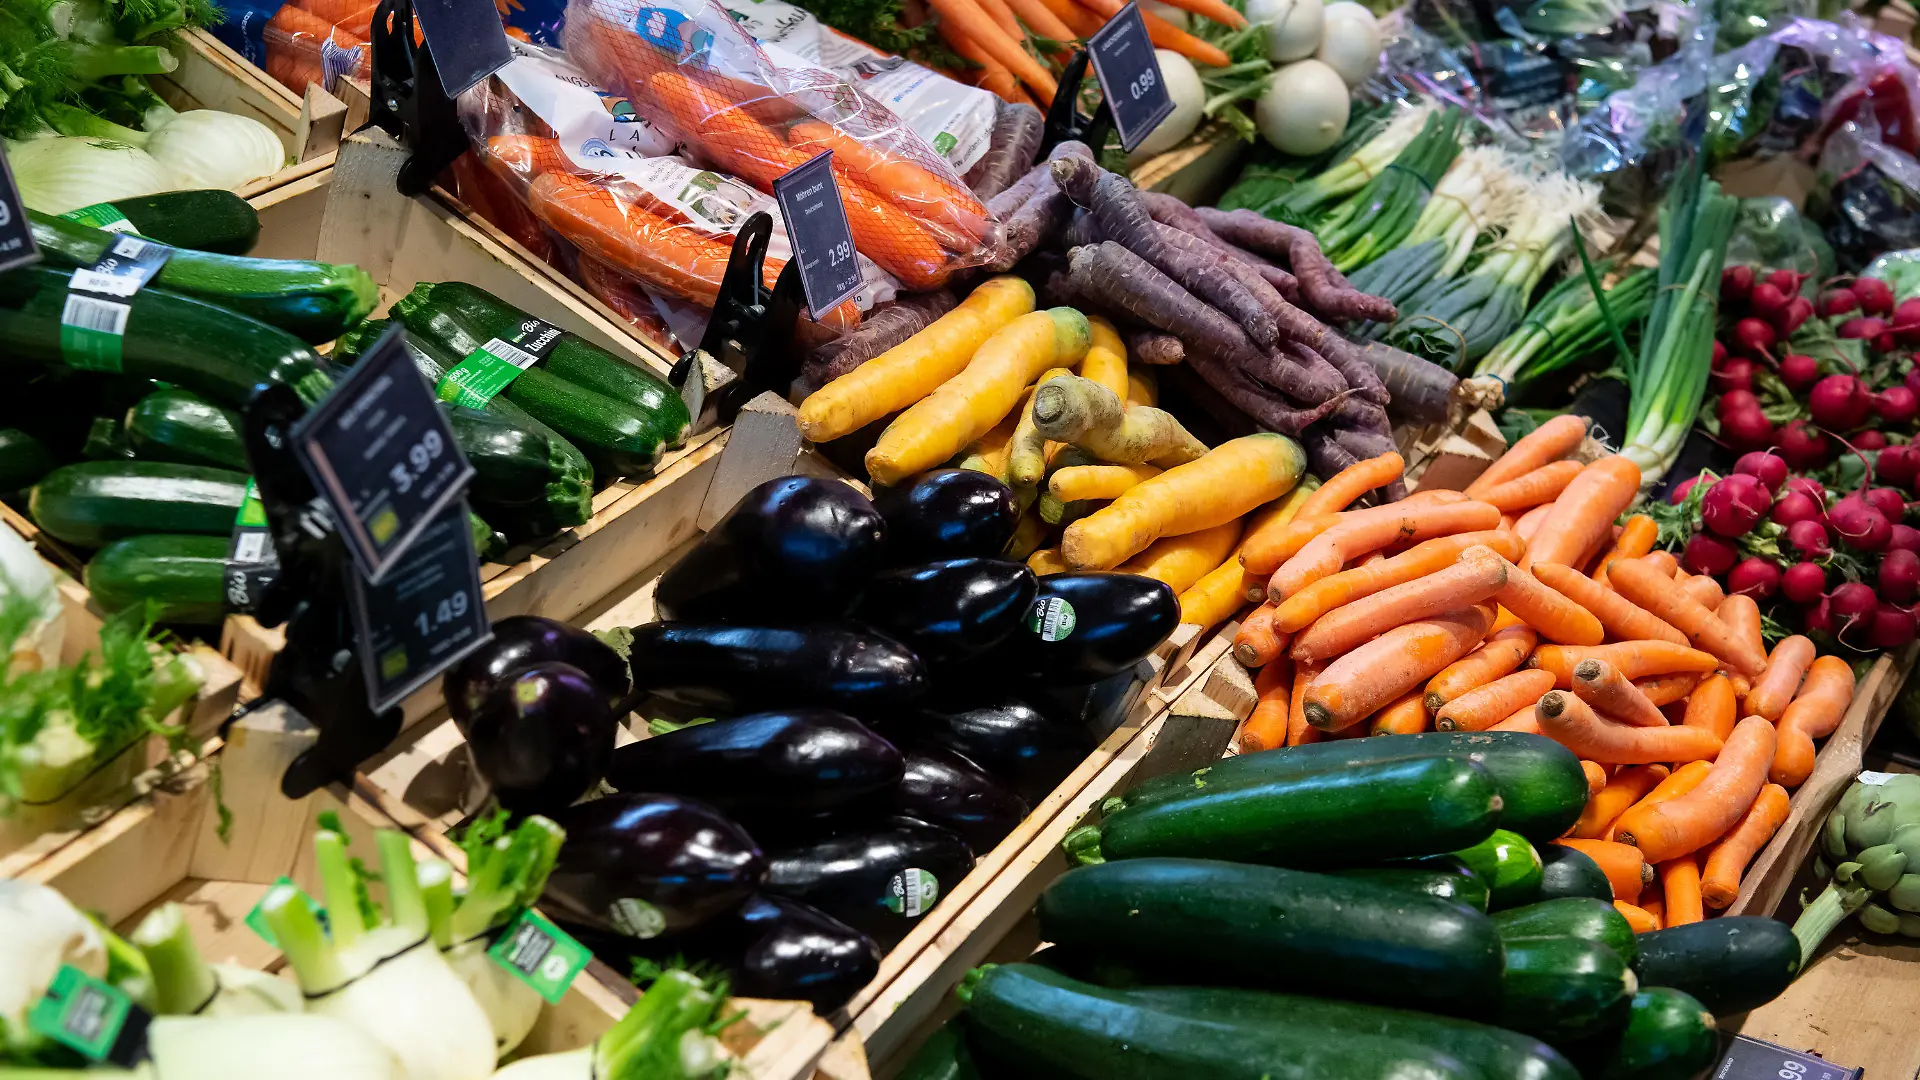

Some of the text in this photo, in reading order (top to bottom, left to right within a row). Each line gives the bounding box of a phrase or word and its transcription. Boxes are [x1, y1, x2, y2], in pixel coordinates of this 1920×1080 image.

[1130, 67, 1156, 100] 0.99
[828, 240, 851, 267] 2.99
[521, 319, 540, 333] Bio
[524, 327, 562, 352] Zucchini
[389, 428, 443, 494] 3.99
[227, 570, 250, 606] Bio
[413, 590, 468, 637] 1.49
[1036, 599, 1046, 618] Bio
[892, 875, 905, 898] Bio
